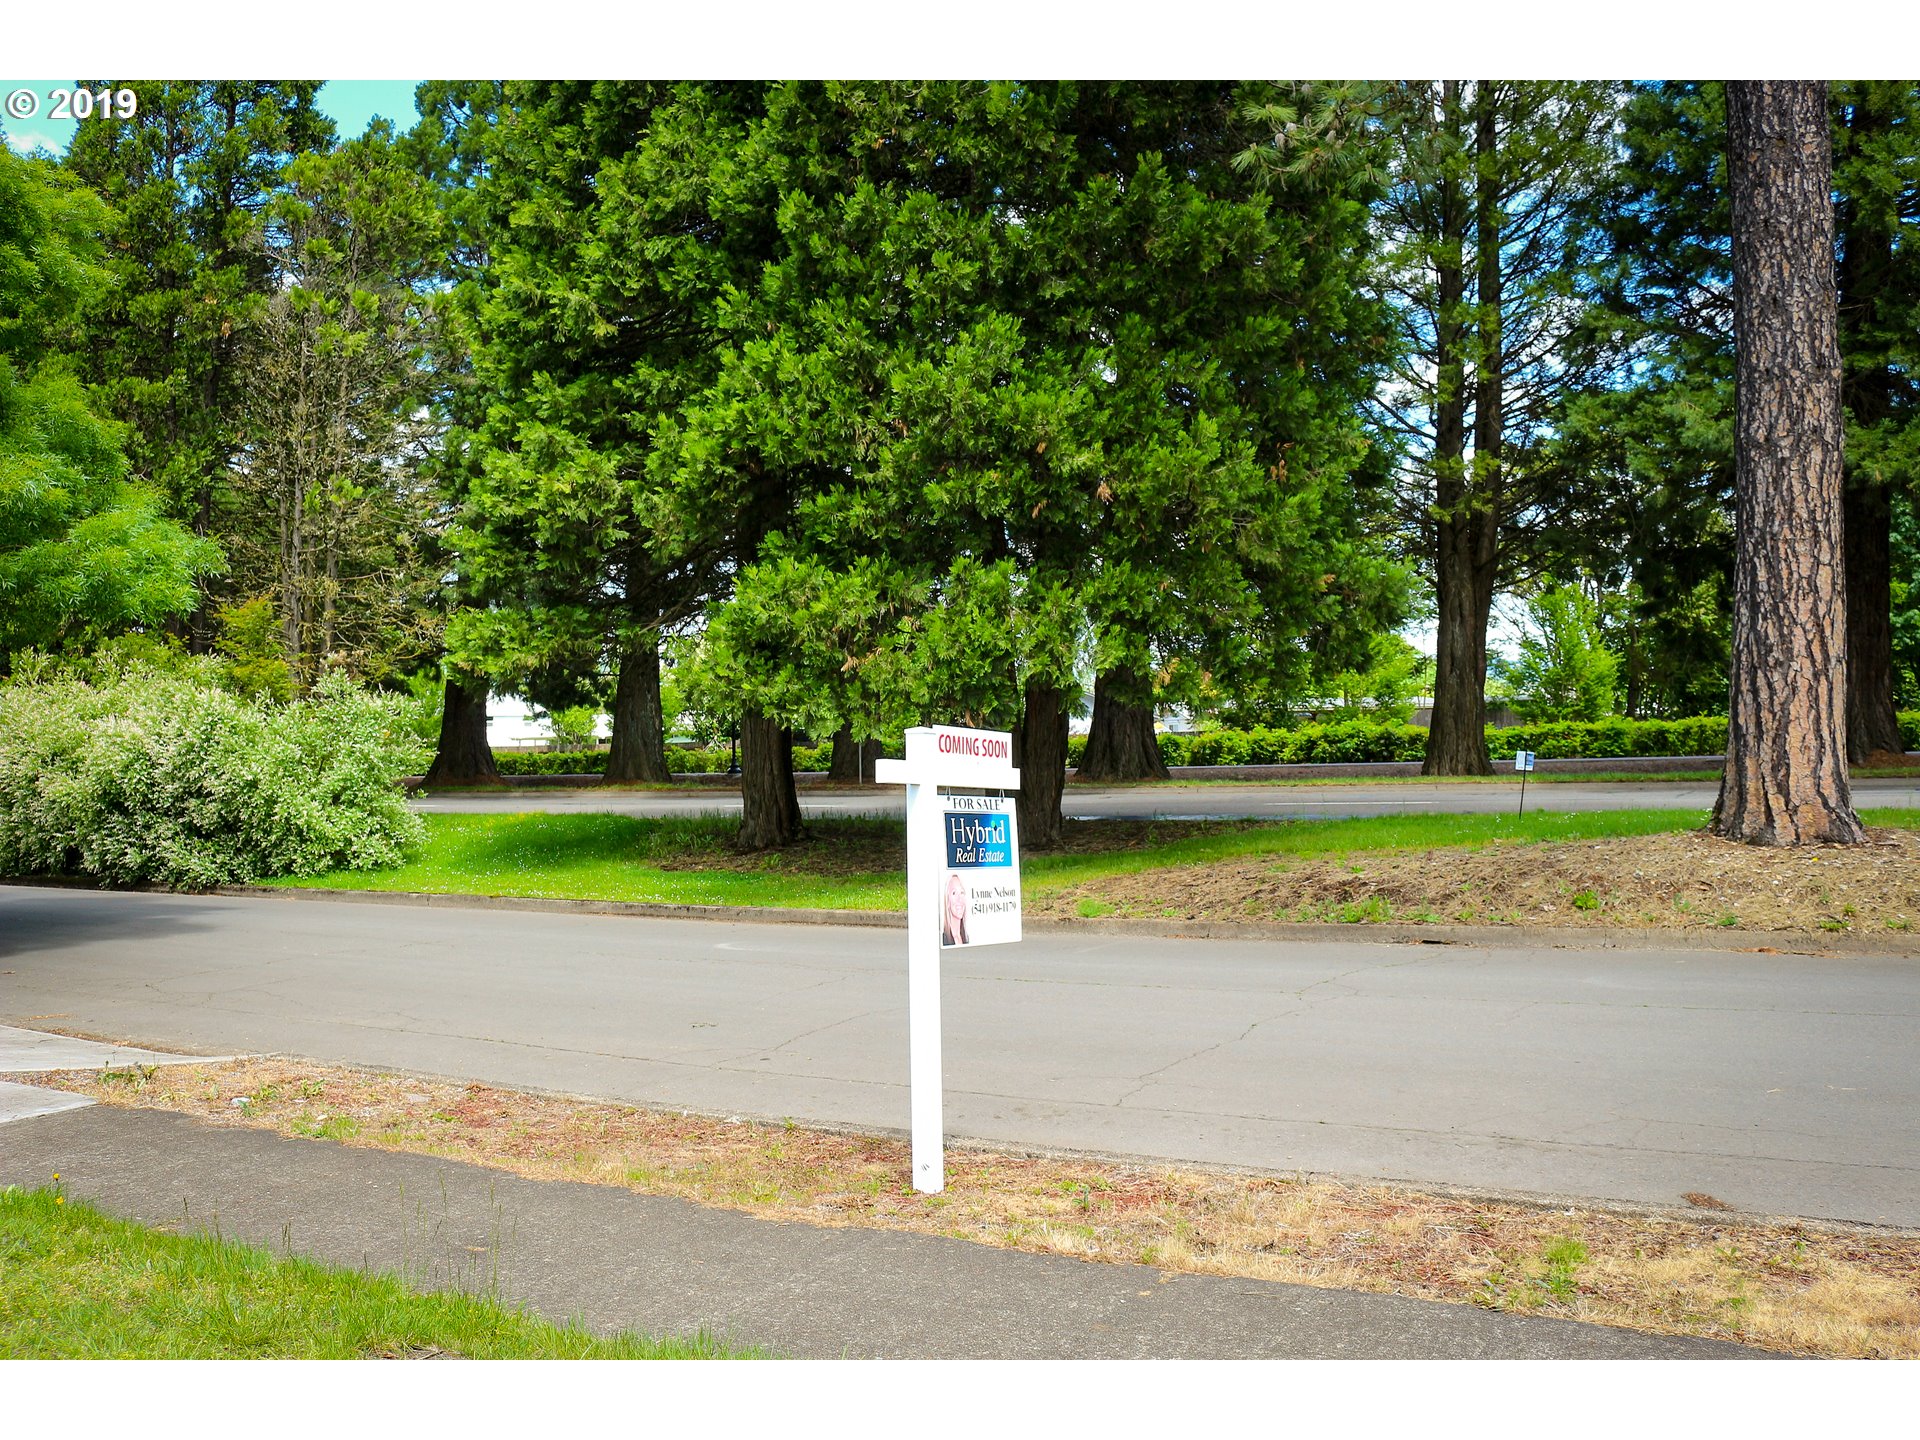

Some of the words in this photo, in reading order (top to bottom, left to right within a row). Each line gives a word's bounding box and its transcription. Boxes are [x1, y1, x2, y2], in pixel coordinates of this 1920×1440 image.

[938, 733, 980, 757] COMING
[982, 738, 1008, 759] SOON
[953, 797, 974, 810] FOR
[976, 798, 1001, 811] SALE
[951, 817, 1006, 850] Hybrid
[955, 848, 976, 863] Real
[978, 848, 1005, 863] Estate
[971, 887, 993, 902] Lynne
[994, 886, 1016, 898] Nelson
